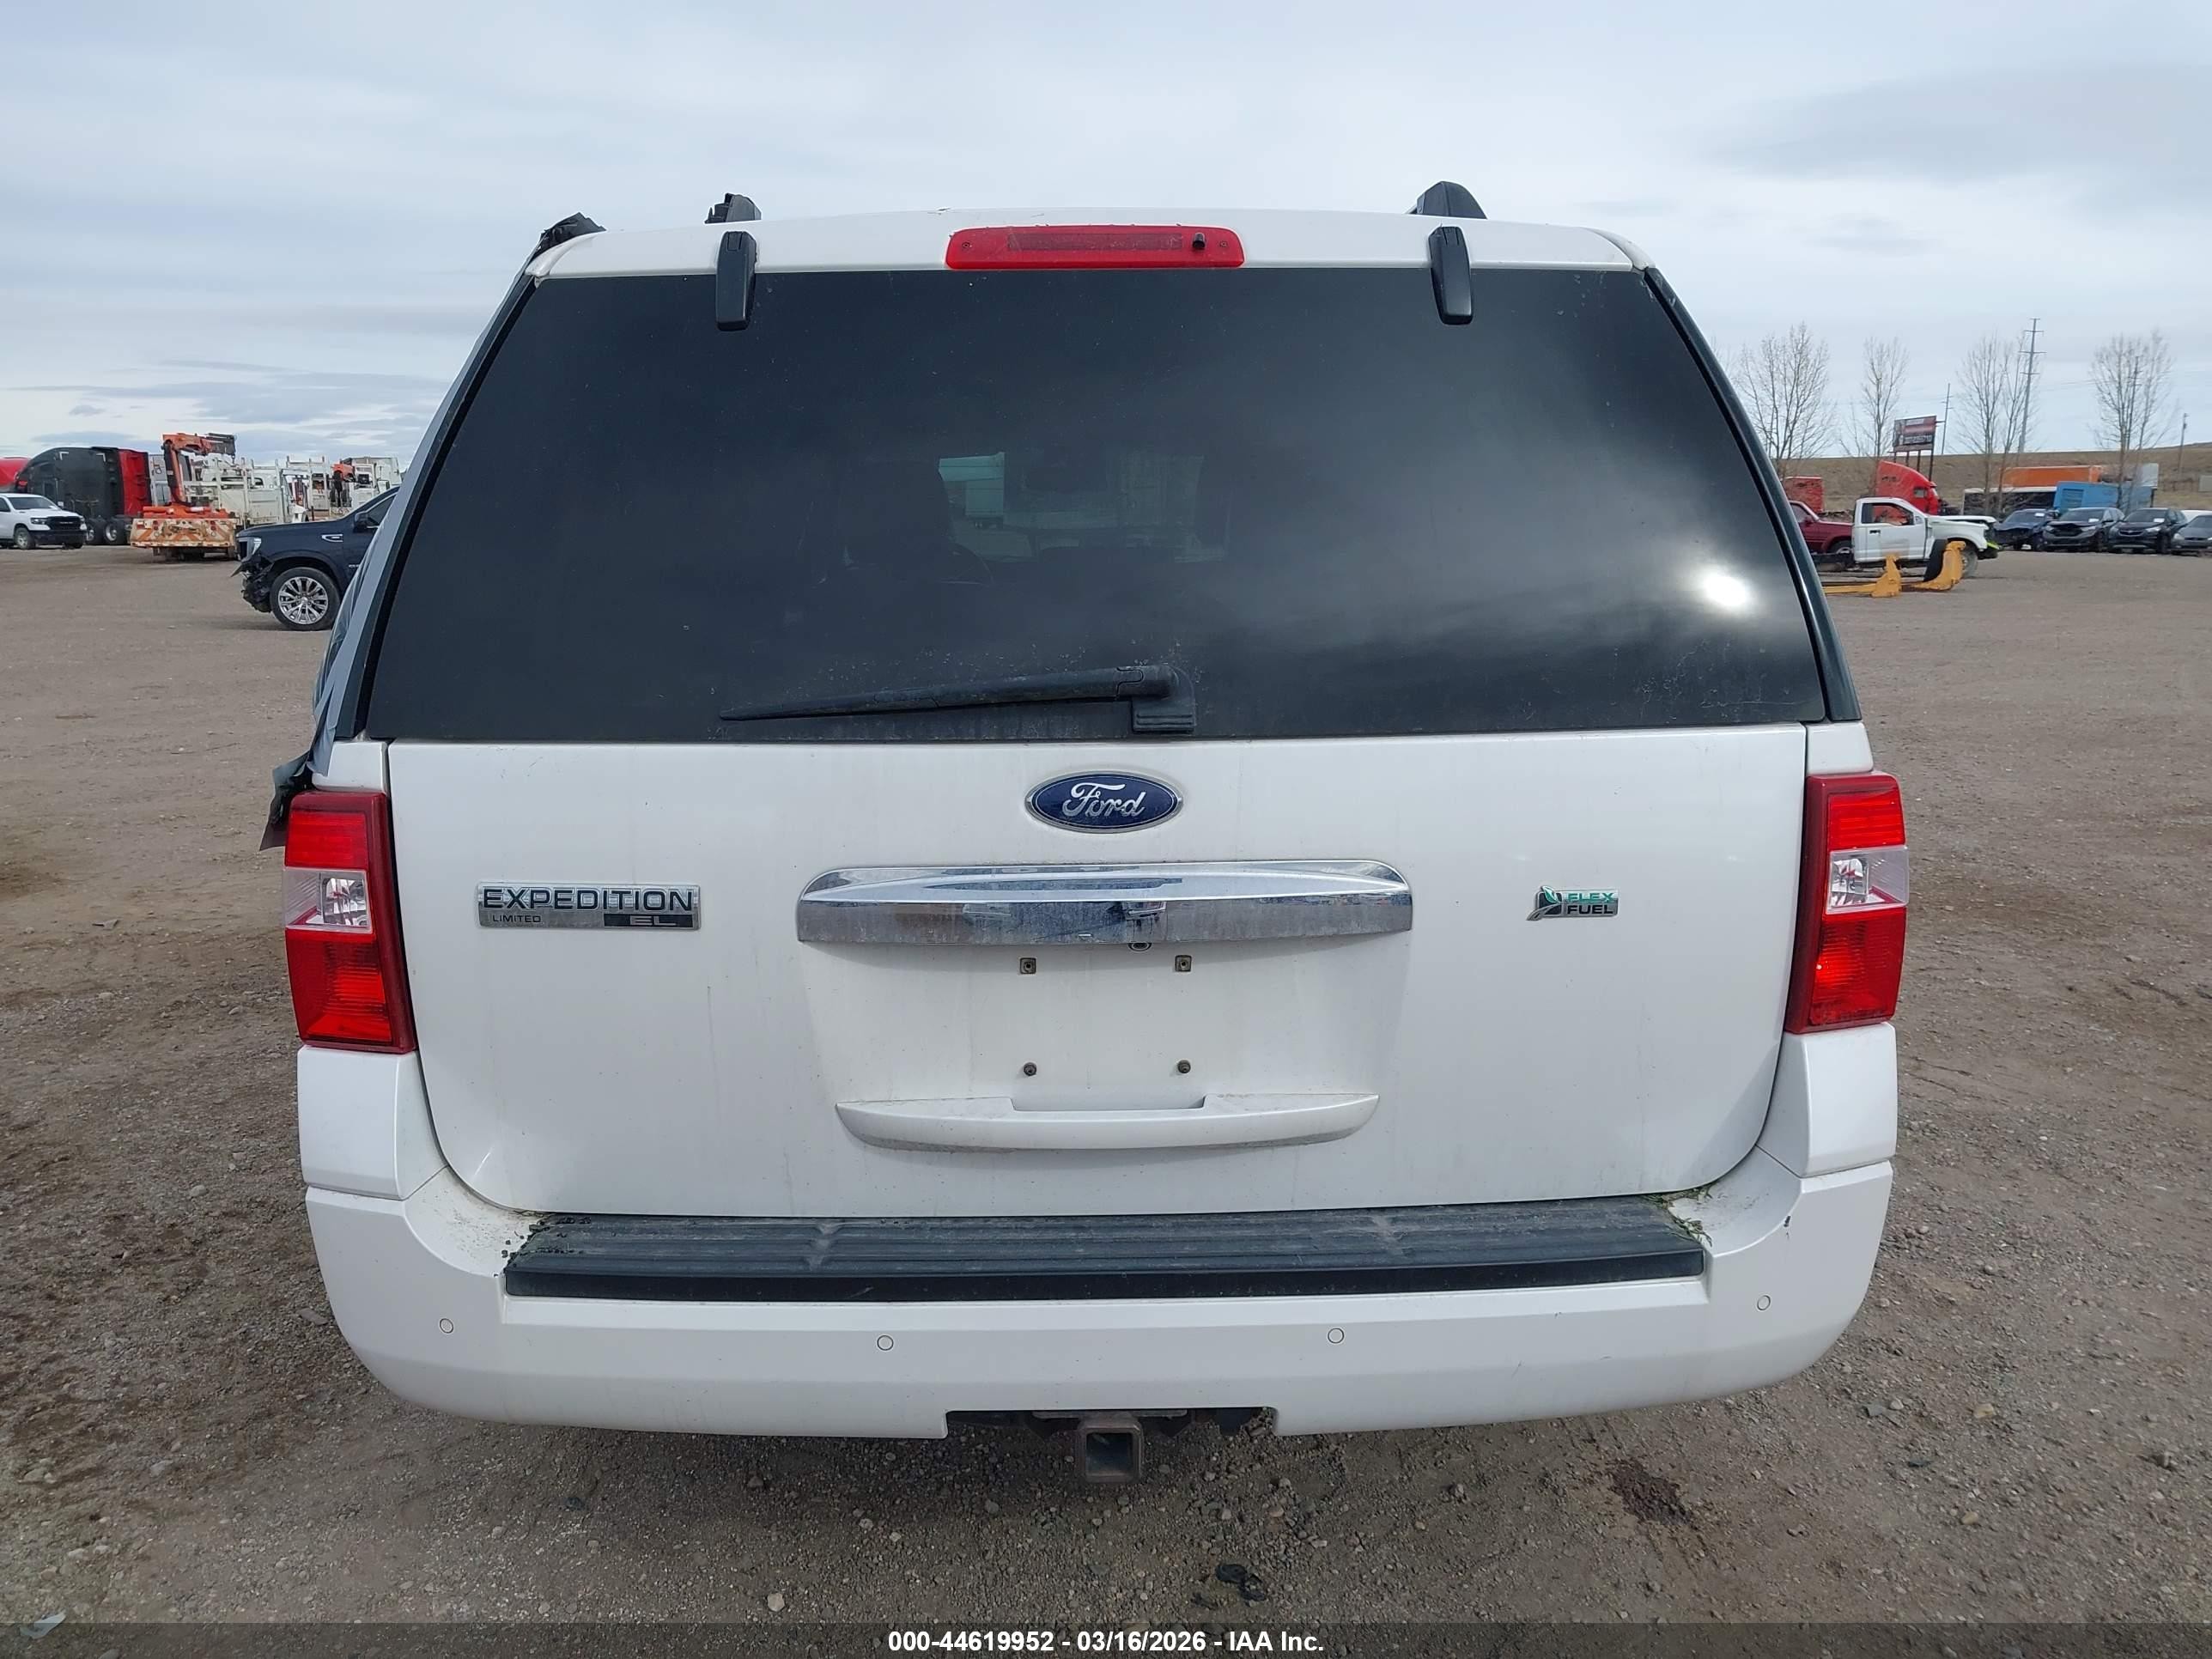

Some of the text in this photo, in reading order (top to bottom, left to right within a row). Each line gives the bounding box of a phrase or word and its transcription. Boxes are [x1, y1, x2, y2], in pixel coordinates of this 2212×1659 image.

[1061, 782, 1146, 817] Ford
[482, 888, 693, 912] EXPEDITION
[1566, 892, 1615, 902] FLEX
[1566, 904, 1614, 915] FUEL
[492, 914, 542, 924] LIMITED
[629, 914, 677, 926] EL
